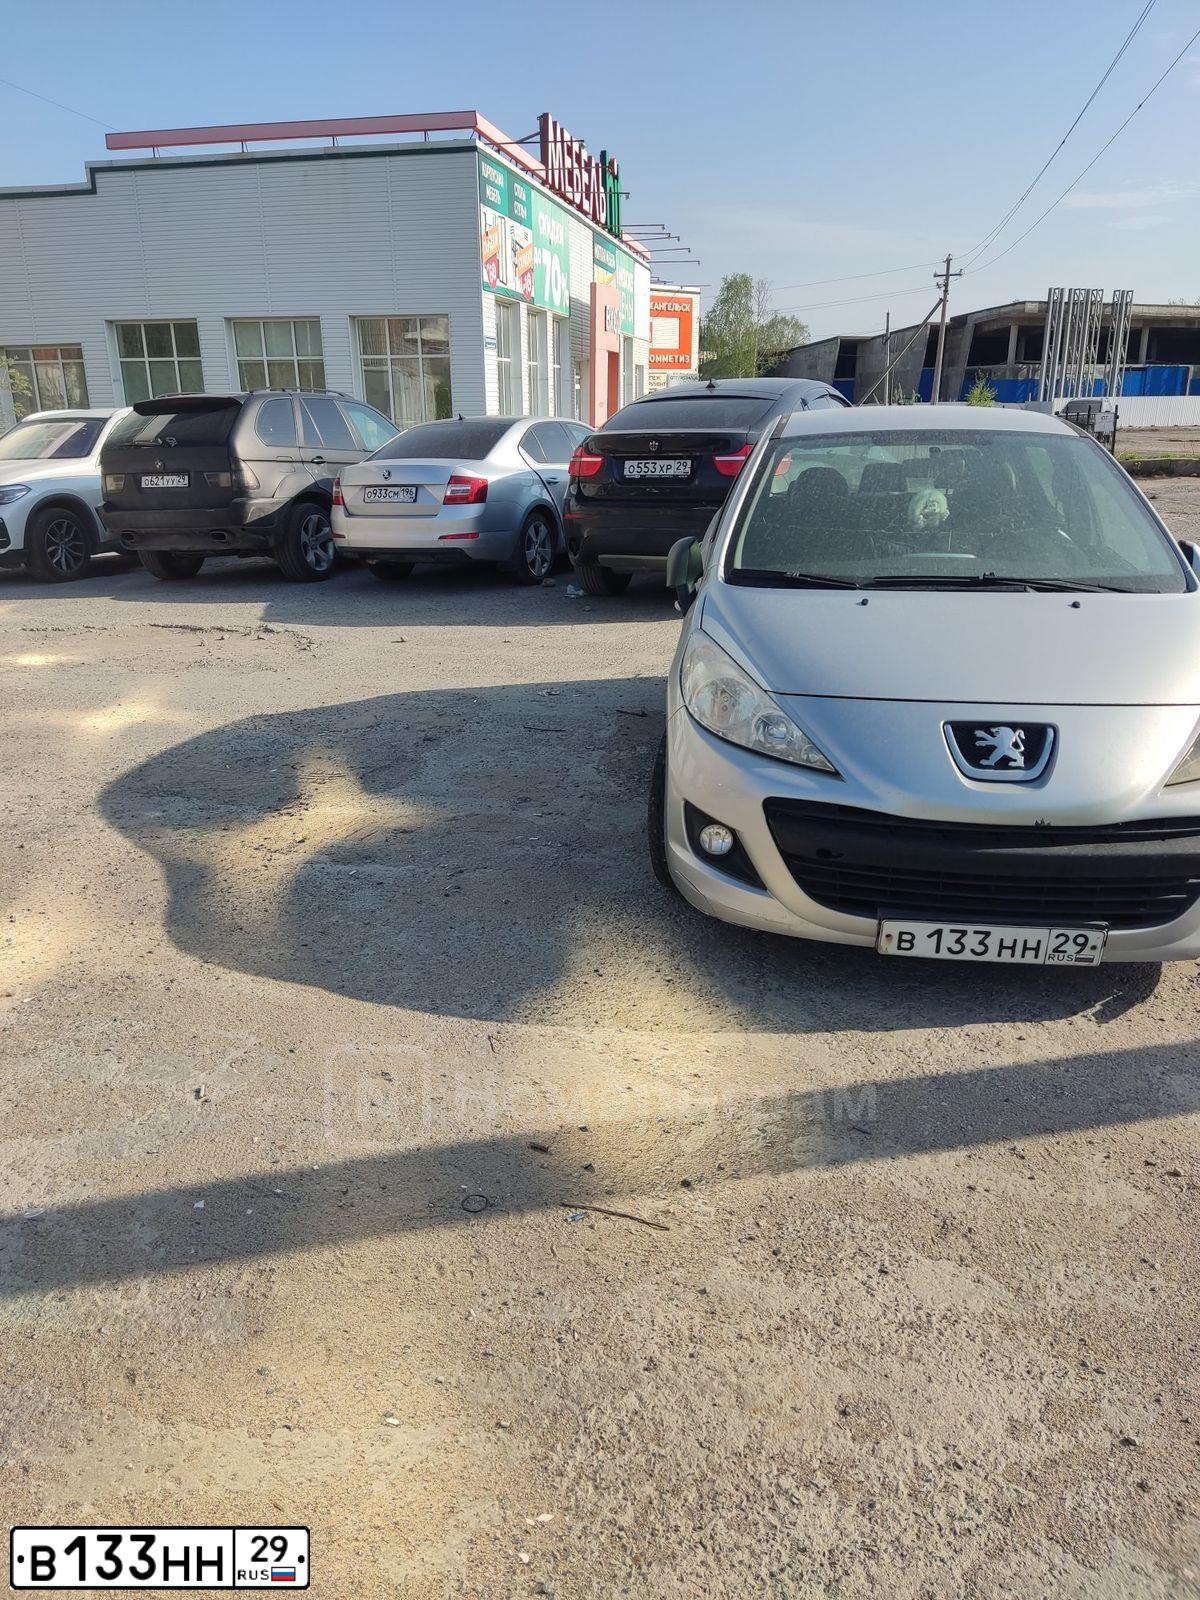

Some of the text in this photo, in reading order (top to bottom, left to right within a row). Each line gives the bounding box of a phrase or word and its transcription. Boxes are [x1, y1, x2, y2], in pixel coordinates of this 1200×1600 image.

[541, 112, 606, 226] МЕБЕЛЬ
[628, 461, 688, 474] О553ХР 29
[401, 487, 414, 496] 196
[1051, 932, 1090, 955] 29
[1047, 953, 1074, 962] RUS
